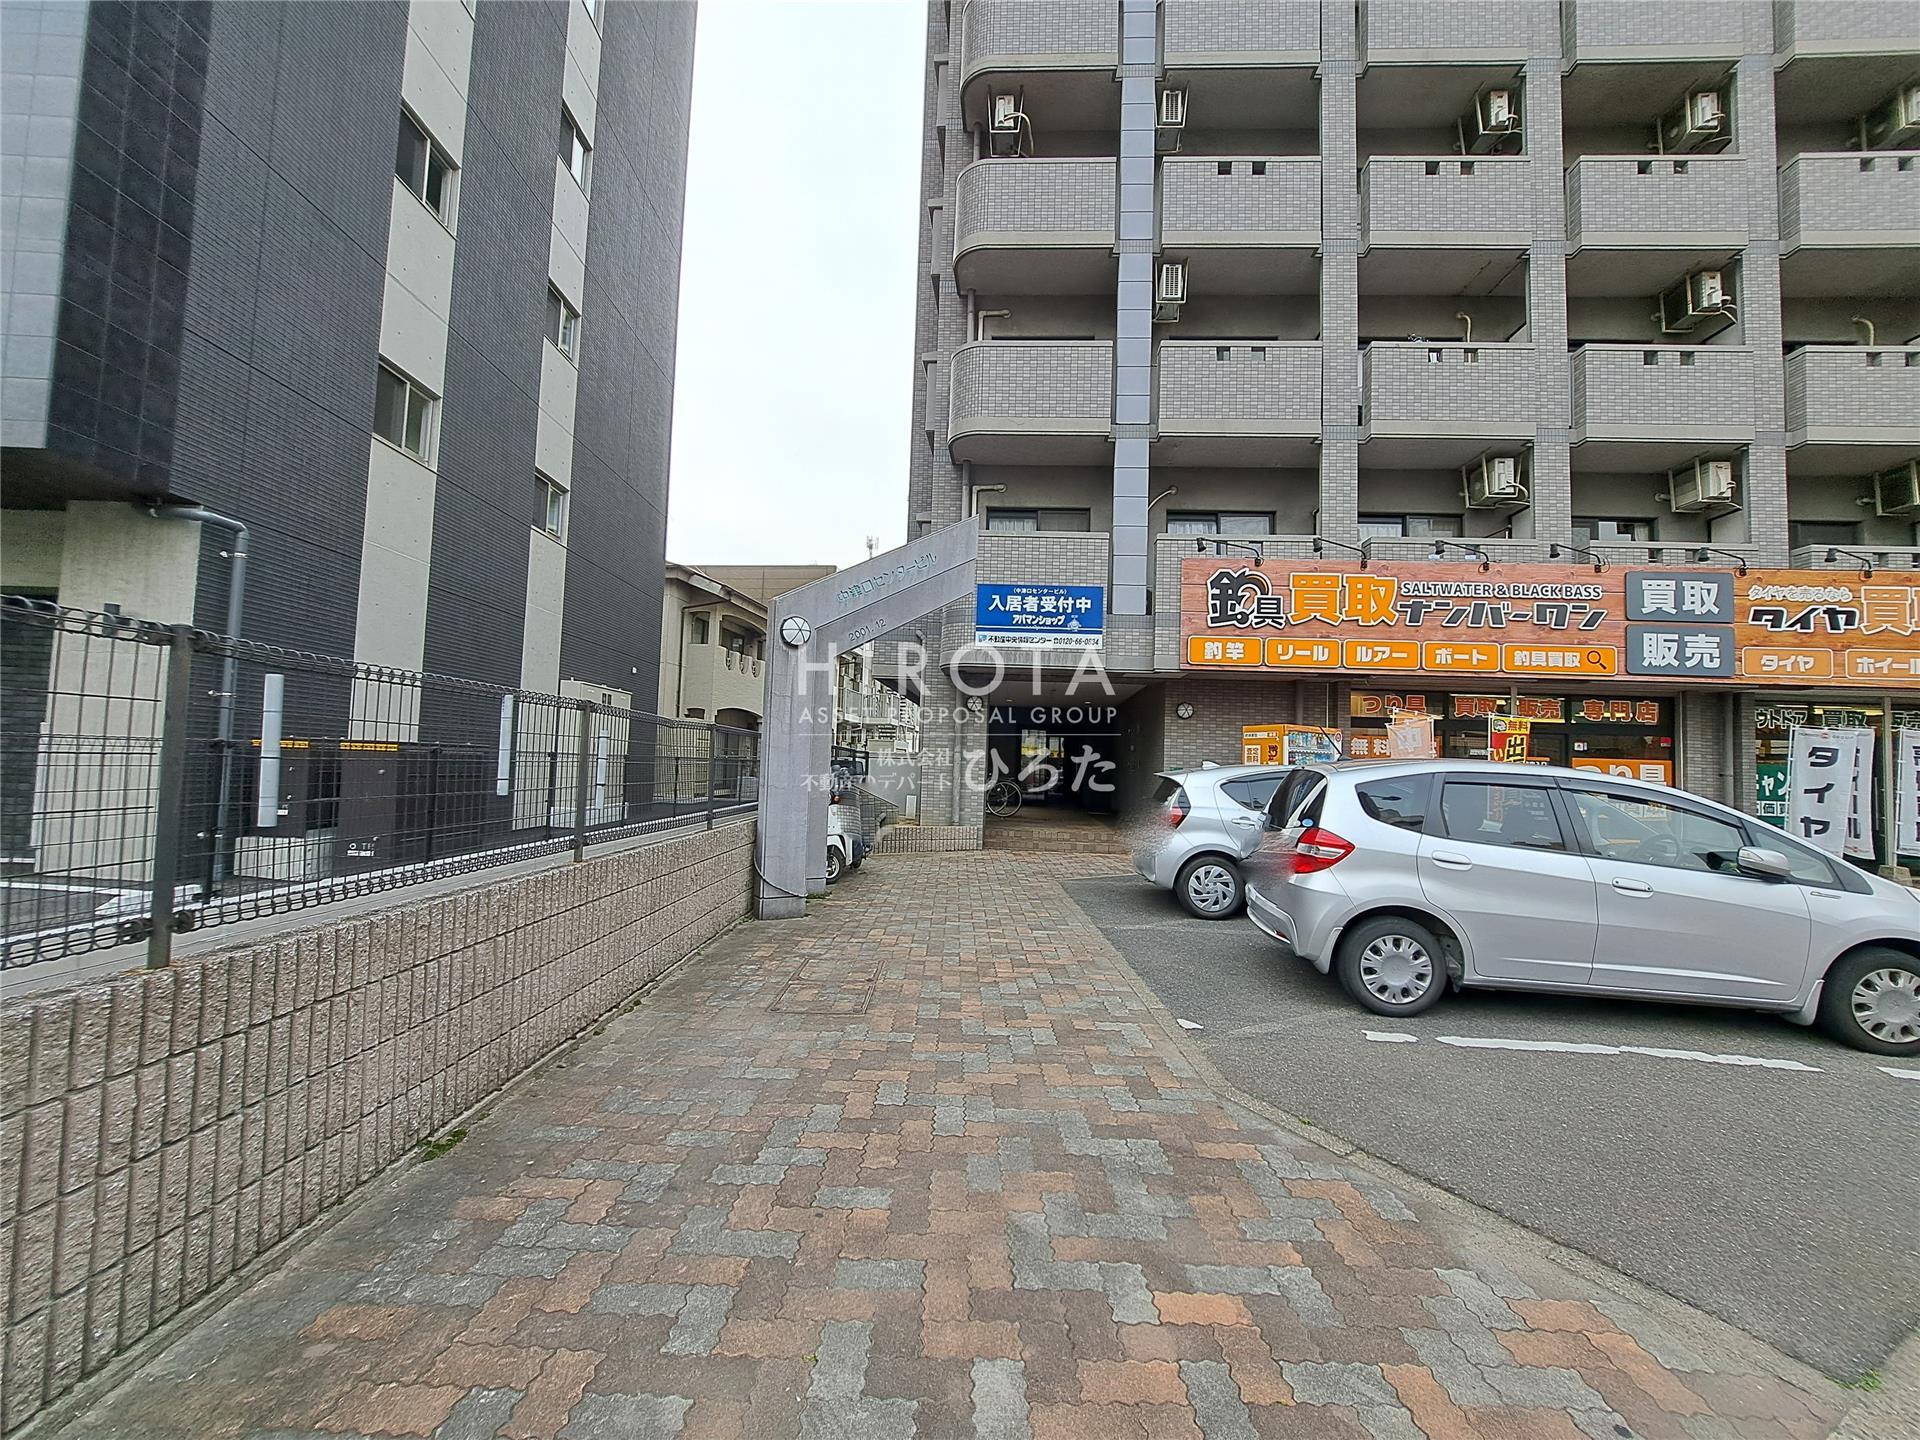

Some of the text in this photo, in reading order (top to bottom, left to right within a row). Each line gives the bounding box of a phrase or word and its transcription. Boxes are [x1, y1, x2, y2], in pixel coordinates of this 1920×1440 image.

[1288, 573, 1399, 627] 買取
[1402, 582, 1602, 599] SALTWATER & BLACK BASS
[1641, 579, 1720, 615] 買取
[1749, 585, 1853, 602] タイヤを売るなら
[988, 595, 1092, 614] 入居者受付中
[1749, 586, 1920, 636] タイヤ 買
[1012, 614, 1066, 626] アパマンショップ
[1398, 600, 1608, 630] ナンバーワン
[1204, 641, 1245, 661] 釣竿
[1277, 644, 1329, 662] リール
[1356, 646, 1408, 663] ルアー
[1435, 648, 1488, 665] ボート
[1514, 650, 1580, 668] 釣具買取
[1642, 632, 1721, 669] 販売
[1760, 655, 1815, 673] タイヤ
[1453, 696, 1498, 718] 買取
[1518, 698, 1561, 719] 販売
[1583, 699, 1659, 722] 専門店
[1756, 771, 1789, 796] ャン
[1799, 746, 1840, 839] タイヤ
